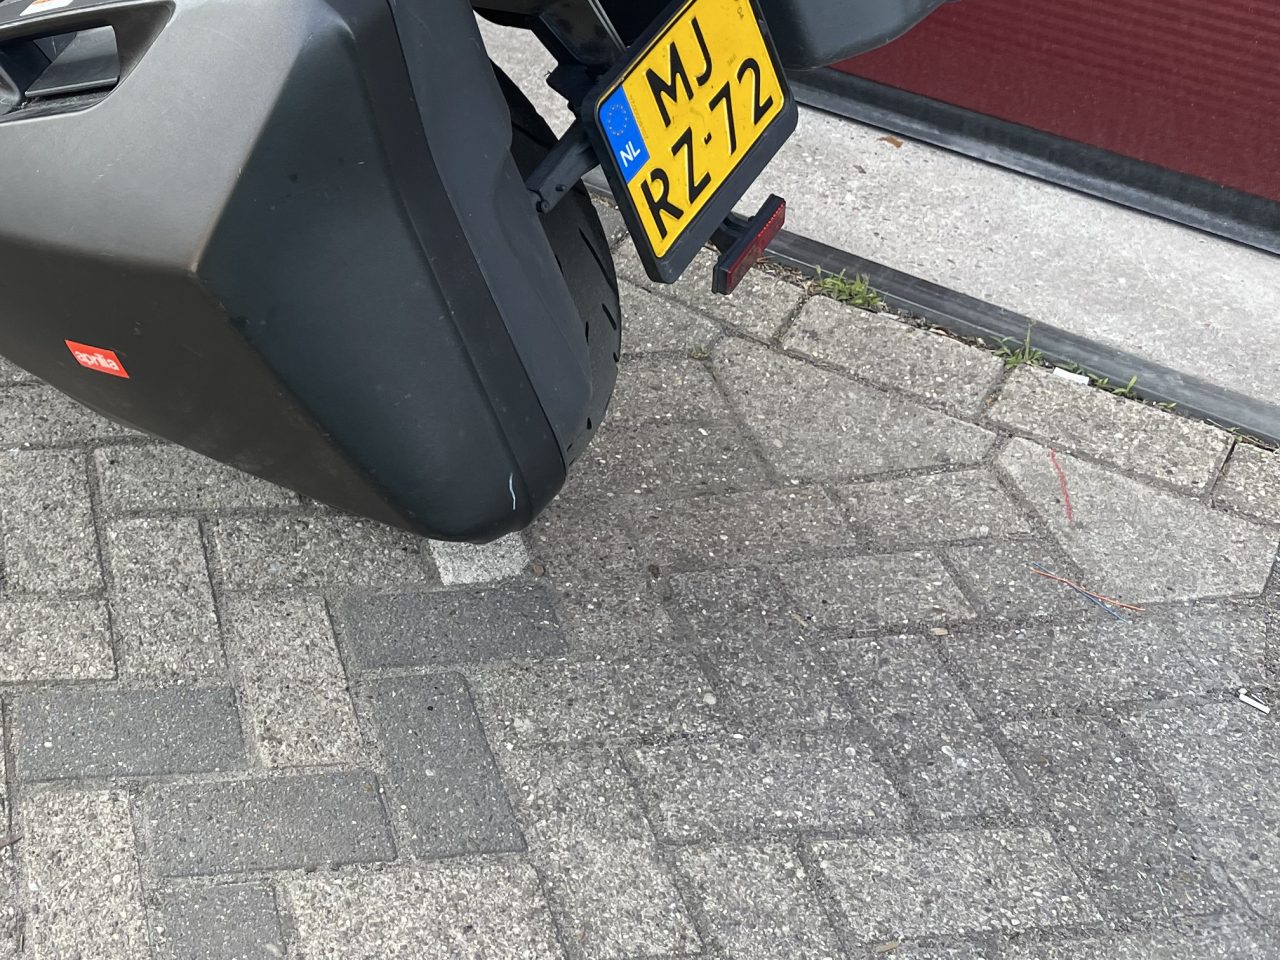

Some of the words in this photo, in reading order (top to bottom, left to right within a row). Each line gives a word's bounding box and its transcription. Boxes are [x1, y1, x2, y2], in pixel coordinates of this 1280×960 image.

[644, 16, 713, 128] MJ
[619, 141, 642, 168] NL
[640, 57, 774, 240] RZ-72
[74, 350, 121, 371] aprilia
